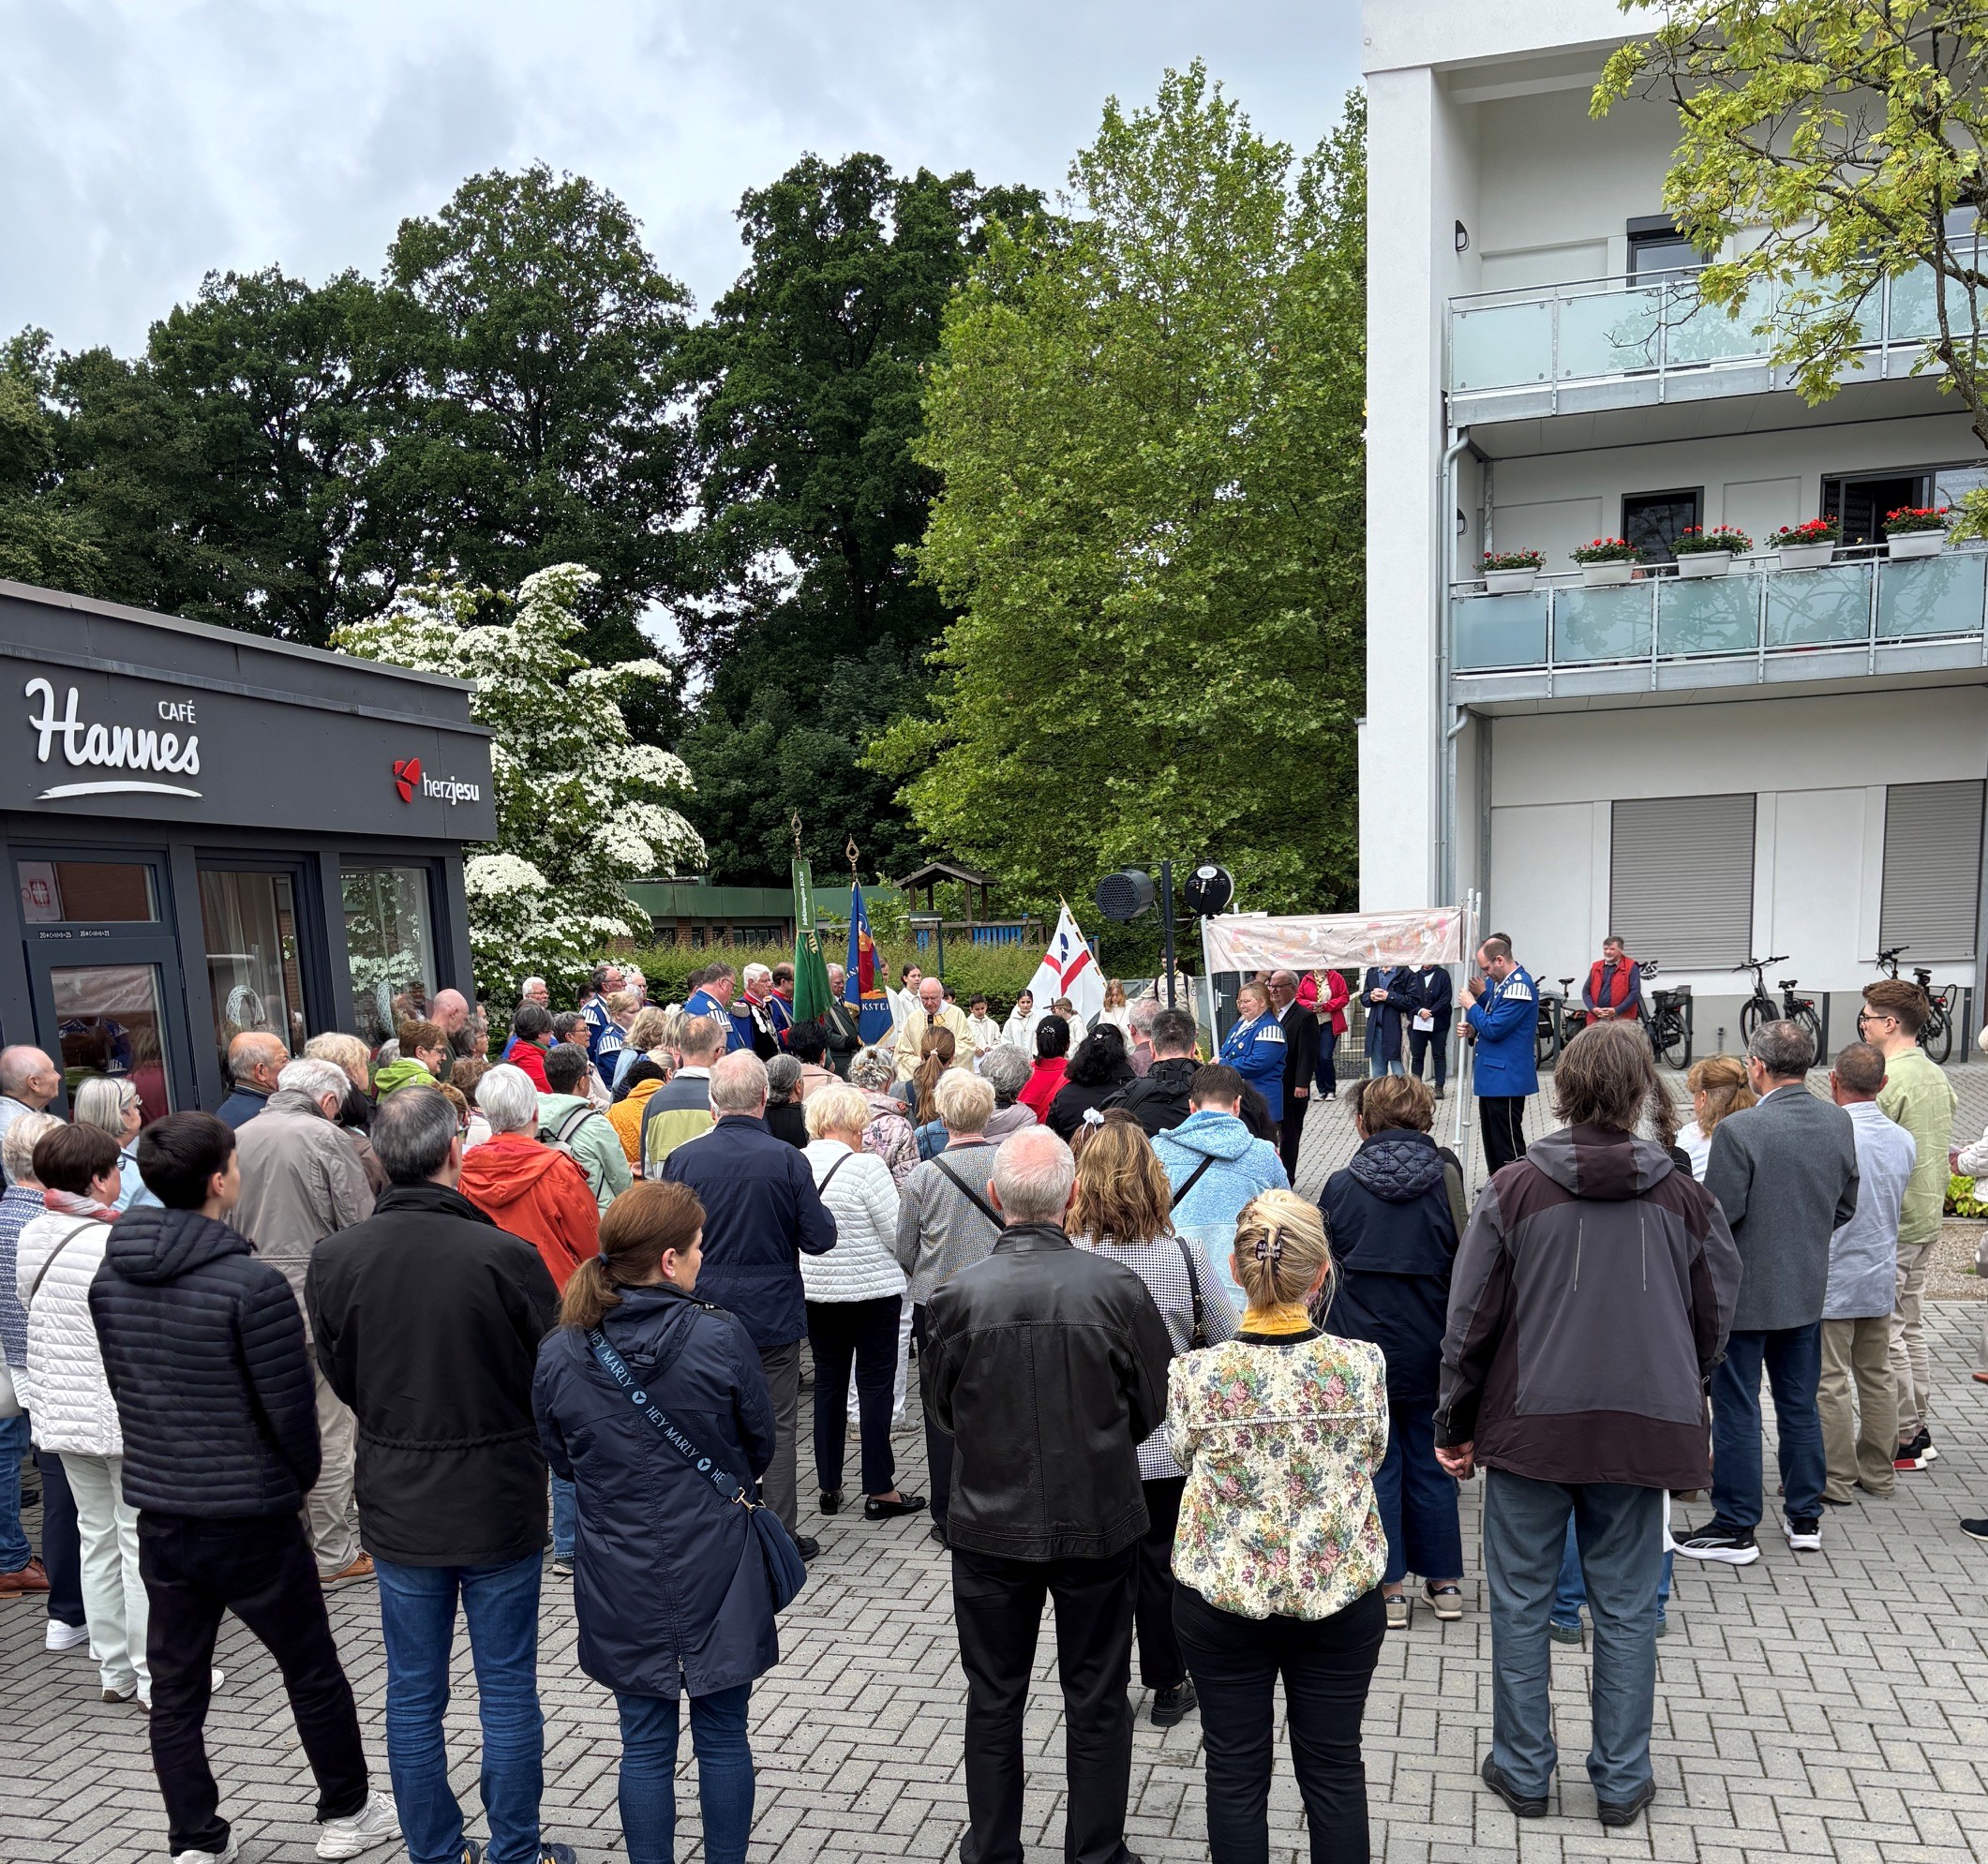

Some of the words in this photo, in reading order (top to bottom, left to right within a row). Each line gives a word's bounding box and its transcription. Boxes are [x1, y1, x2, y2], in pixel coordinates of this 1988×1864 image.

[24, 678, 200, 775] Hannes
[157, 700, 197, 724] CAFÉ
[421, 771, 480, 806] herzjesu
[589, 1328, 607, 1350] HEY
[601, 1350, 635, 1387] MARLY
[645, 1405, 669, 1427] HEY
[664, 1426, 700, 1458] MARLY
